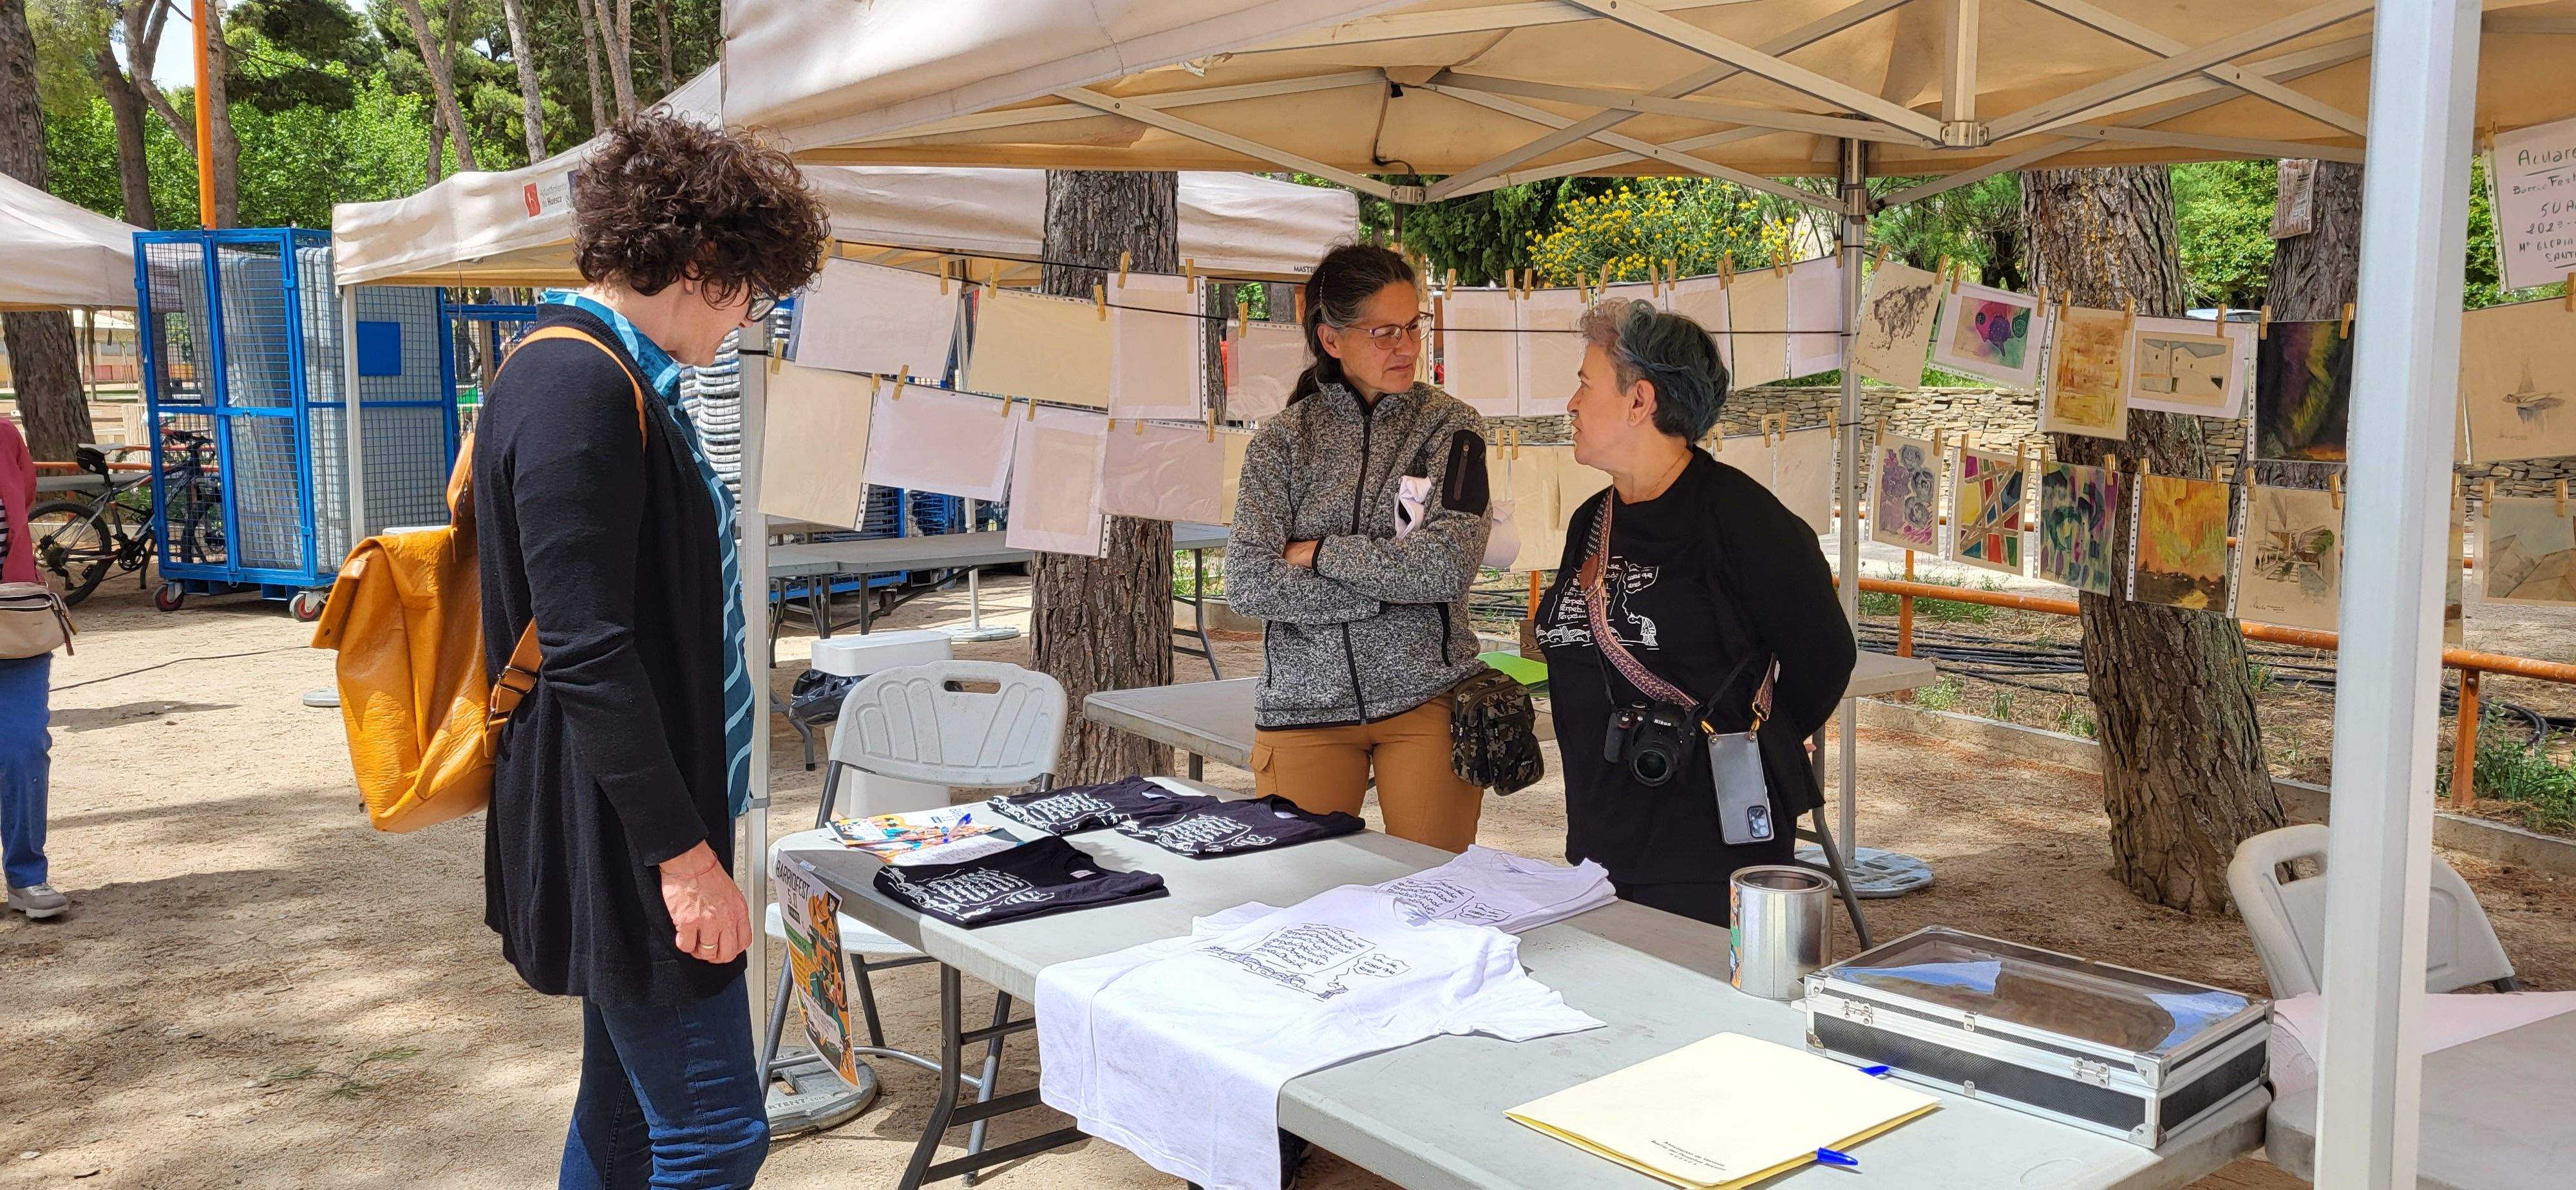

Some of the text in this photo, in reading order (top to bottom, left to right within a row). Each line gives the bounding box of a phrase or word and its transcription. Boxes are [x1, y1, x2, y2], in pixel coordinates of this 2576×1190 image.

[547, 196, 562, 207] Huesca
[2566, 200, 2576, 212] A
[776, 860, 810, 902] BARRIOFEST
[788, 889, 798, 909] 5.0
